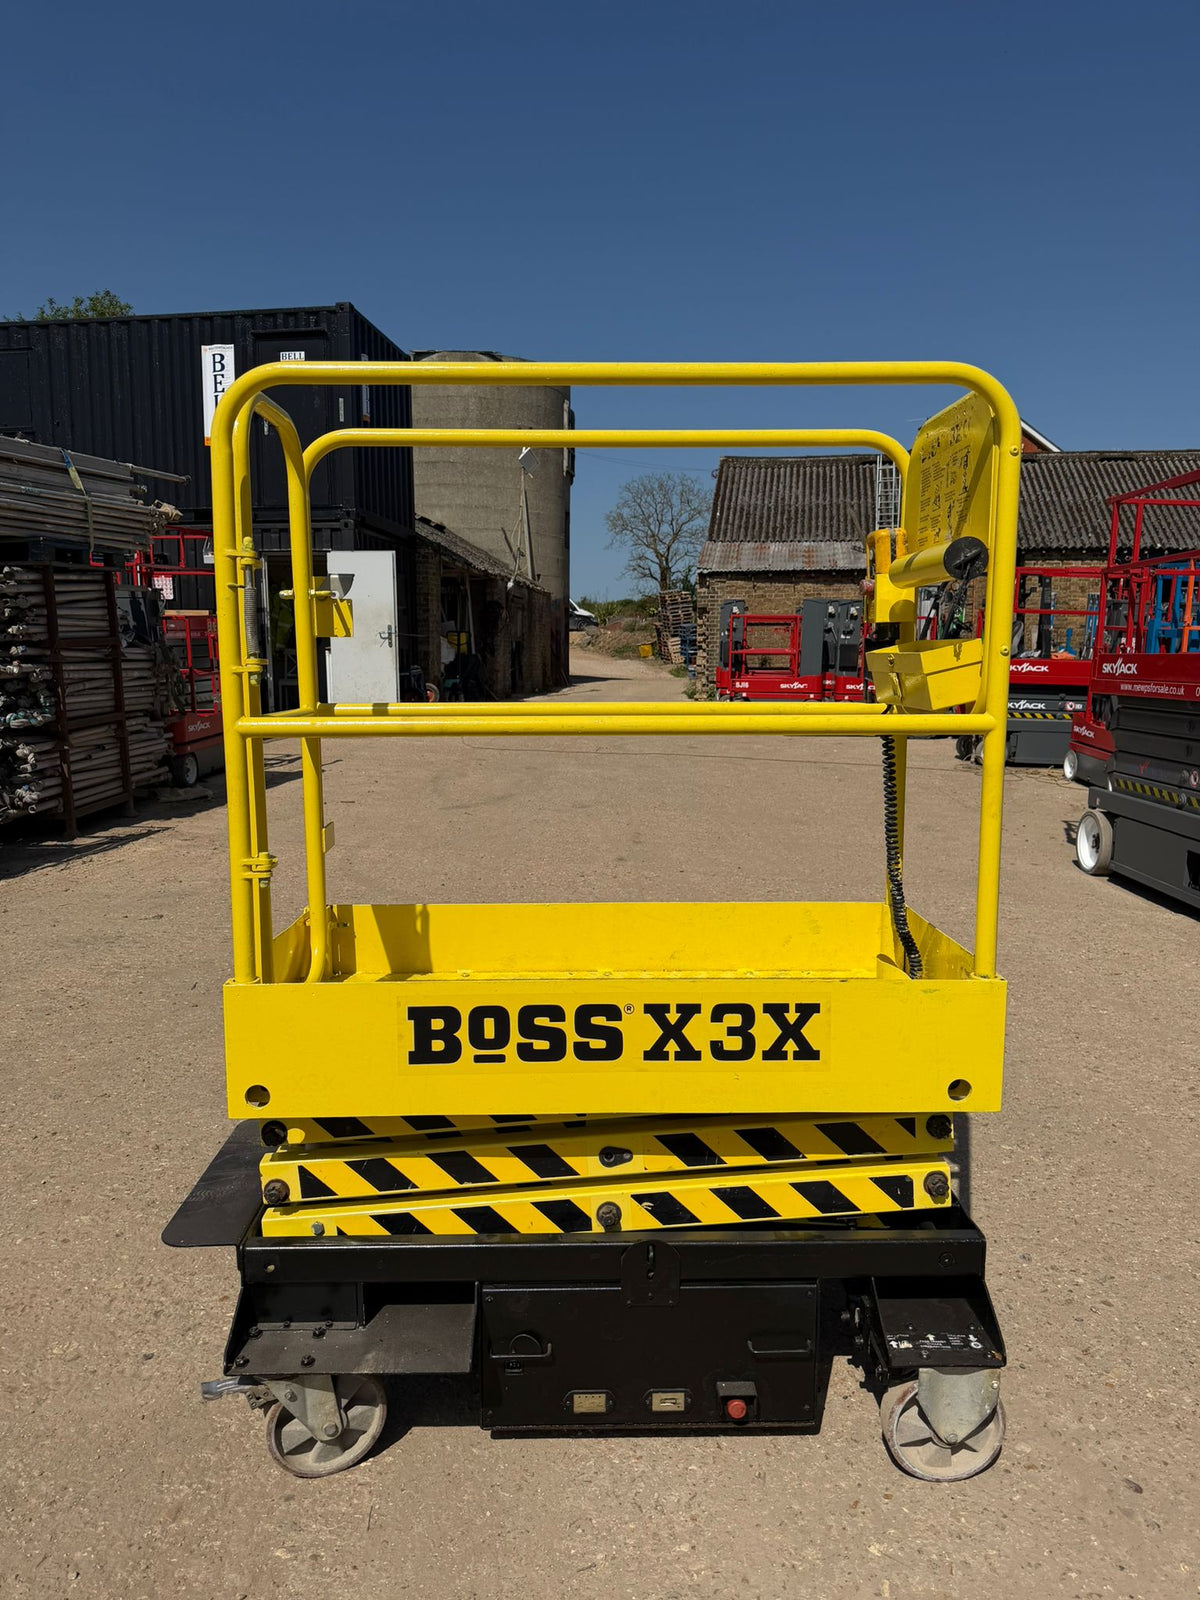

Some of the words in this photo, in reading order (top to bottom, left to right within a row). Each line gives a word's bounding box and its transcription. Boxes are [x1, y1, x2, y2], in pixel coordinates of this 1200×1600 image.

[1009, 662, 1049, 673] KYJACK
[1102, 658, 1138, 676] SKYJACK
[1120, 683, 1185, 695] www.mewpsforsale.co.uk
[1007, 699, 1046, 710] KYJACK
[643, 1003, 820, 1062] X3X
